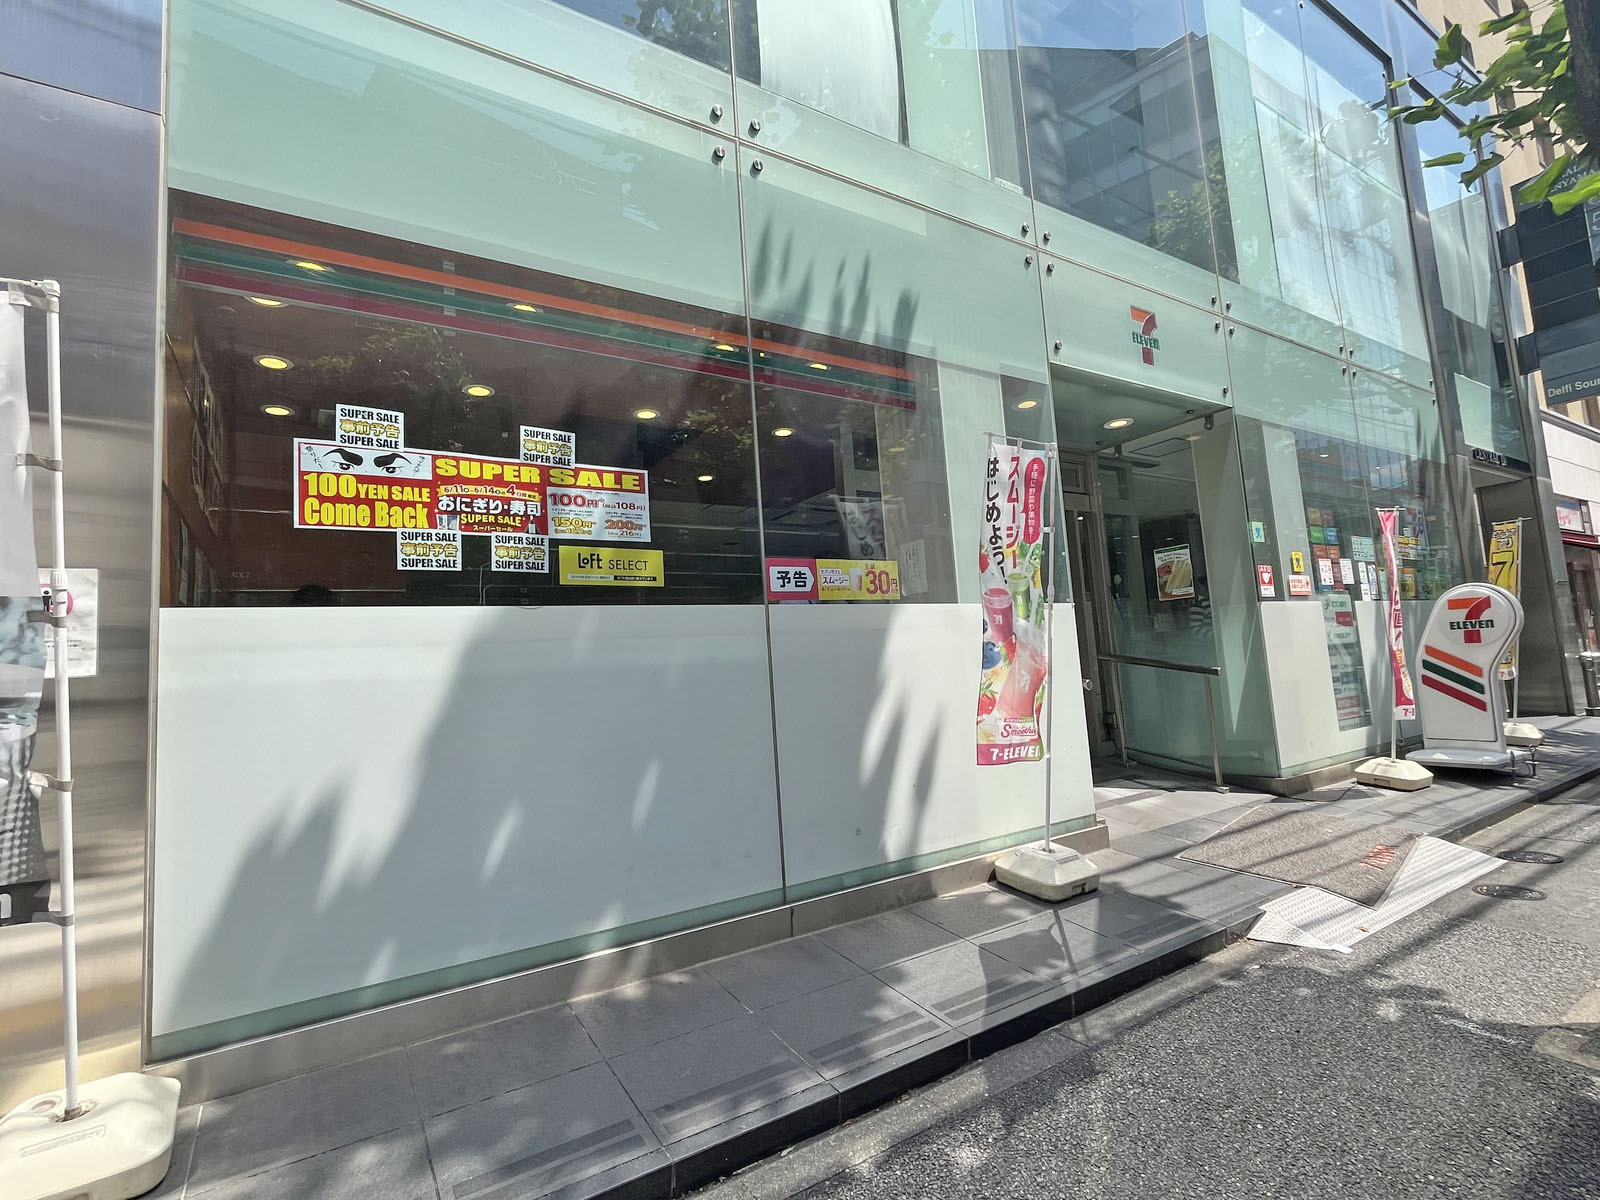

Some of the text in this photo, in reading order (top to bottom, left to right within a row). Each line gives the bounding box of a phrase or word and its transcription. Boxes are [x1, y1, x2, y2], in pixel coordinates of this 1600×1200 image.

[1130, 304, 1158, 366] 7
[1547, 383, 1573, 398] Delfi
[340, 408, 400, 424] SUPER SALE
[340, 418, 400, 439] 事前予告
[340, 434, 400, 450] SUPER SALE
[523, 429, 572, 444] SUPER SALE
[523, 439, 572, 457] 事前予告
[523, 453, 572, 467] SUPER SALE
[435, 458, 541, 484] SUPER
[549, 468, 640, 491] SALE
[391, 485, 431, 502] SALE
[304, 497, 430, 528] Come Back
[438, 495, 541, 517] おにぎり・寿司
[1006, 456, 1020, 569] スムージー
[460, 513, 522, 527] SUPER SALE
[400, 531, 457, 542] SUPER SALE
[495, 535, 546, 546] SUPER SALE
[400, 542, 459, 557] 事前予告
[495, 545, 547, 560] 事前予告
[401, 558, 458, 569] SUPER SALE
[495, 560, 546, 571] SUPER SALE
[608, 559, 649, 571] SELECT
[776, 570, 808, 588] 予告
[822, 576, 849, 585] スムージー
[1447, 595, 1492, 644] 7
